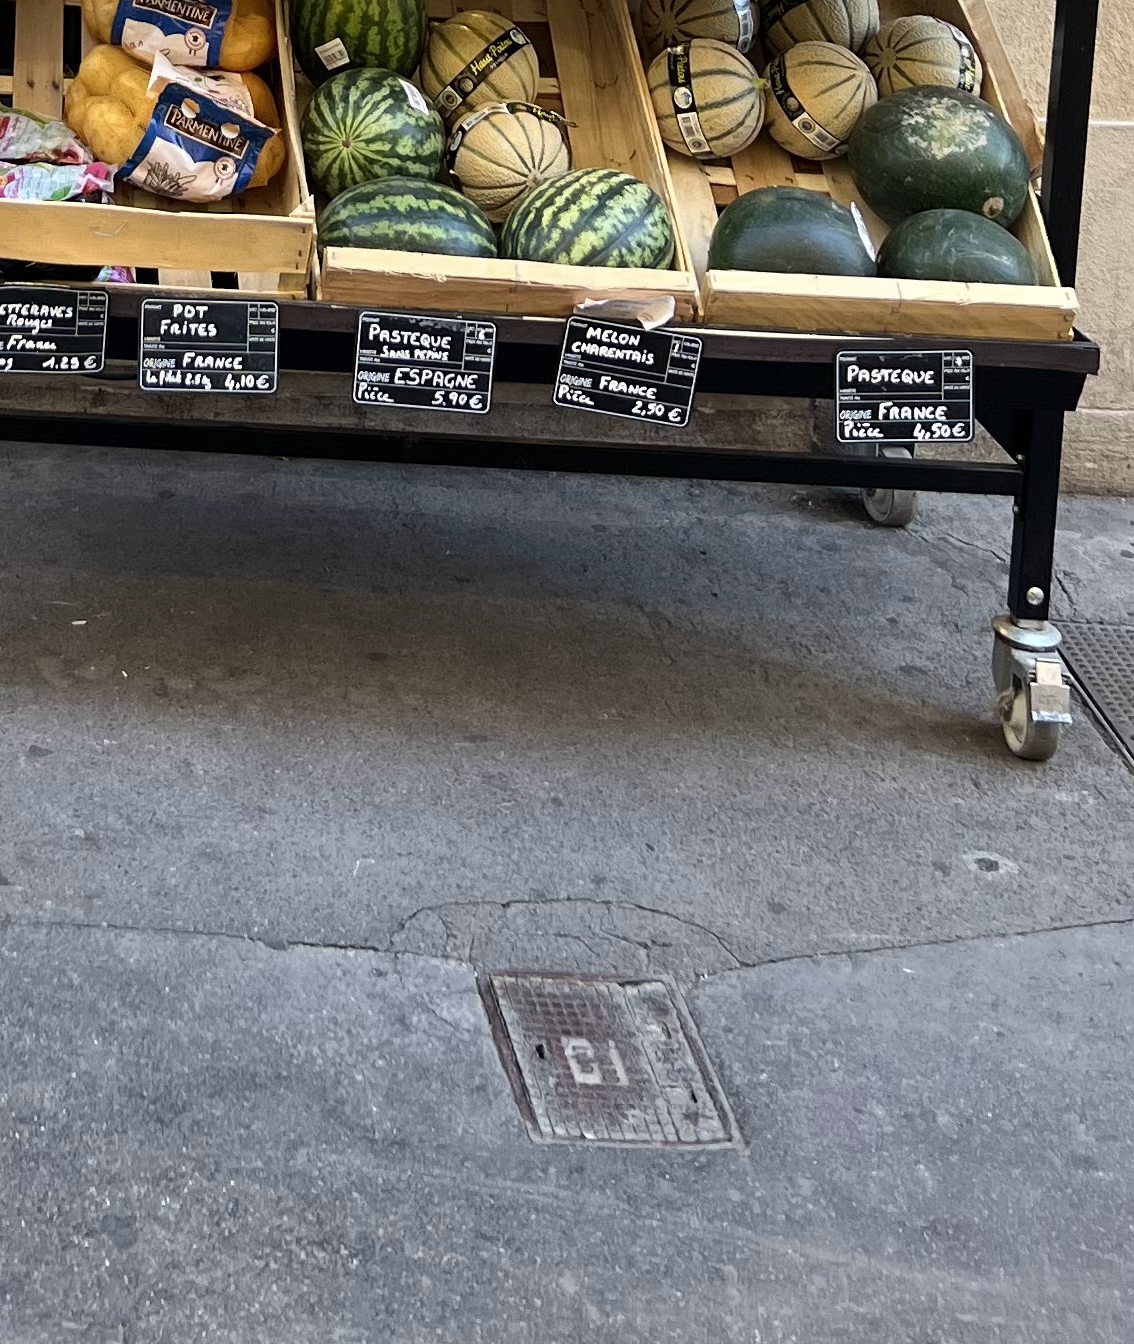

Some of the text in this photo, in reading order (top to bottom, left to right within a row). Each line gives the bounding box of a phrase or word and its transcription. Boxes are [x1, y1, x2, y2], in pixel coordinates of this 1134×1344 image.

[171, 110, 244, 151] PARMENTINE
[173, 304, 209, 319] PDT
[369, 324, 452, 349] PASTEQUE
[586, 327, 640, 346] MELON
[144, 352, 242, 370] ORIGINE FRANCE
[394, 368, 478, 389] ESPAGNE
[847, 364, 935, 384] PASTEQUE
[599, 376, 657, 400] FRANCE
[878, 401, 947, 420] FRANCE
